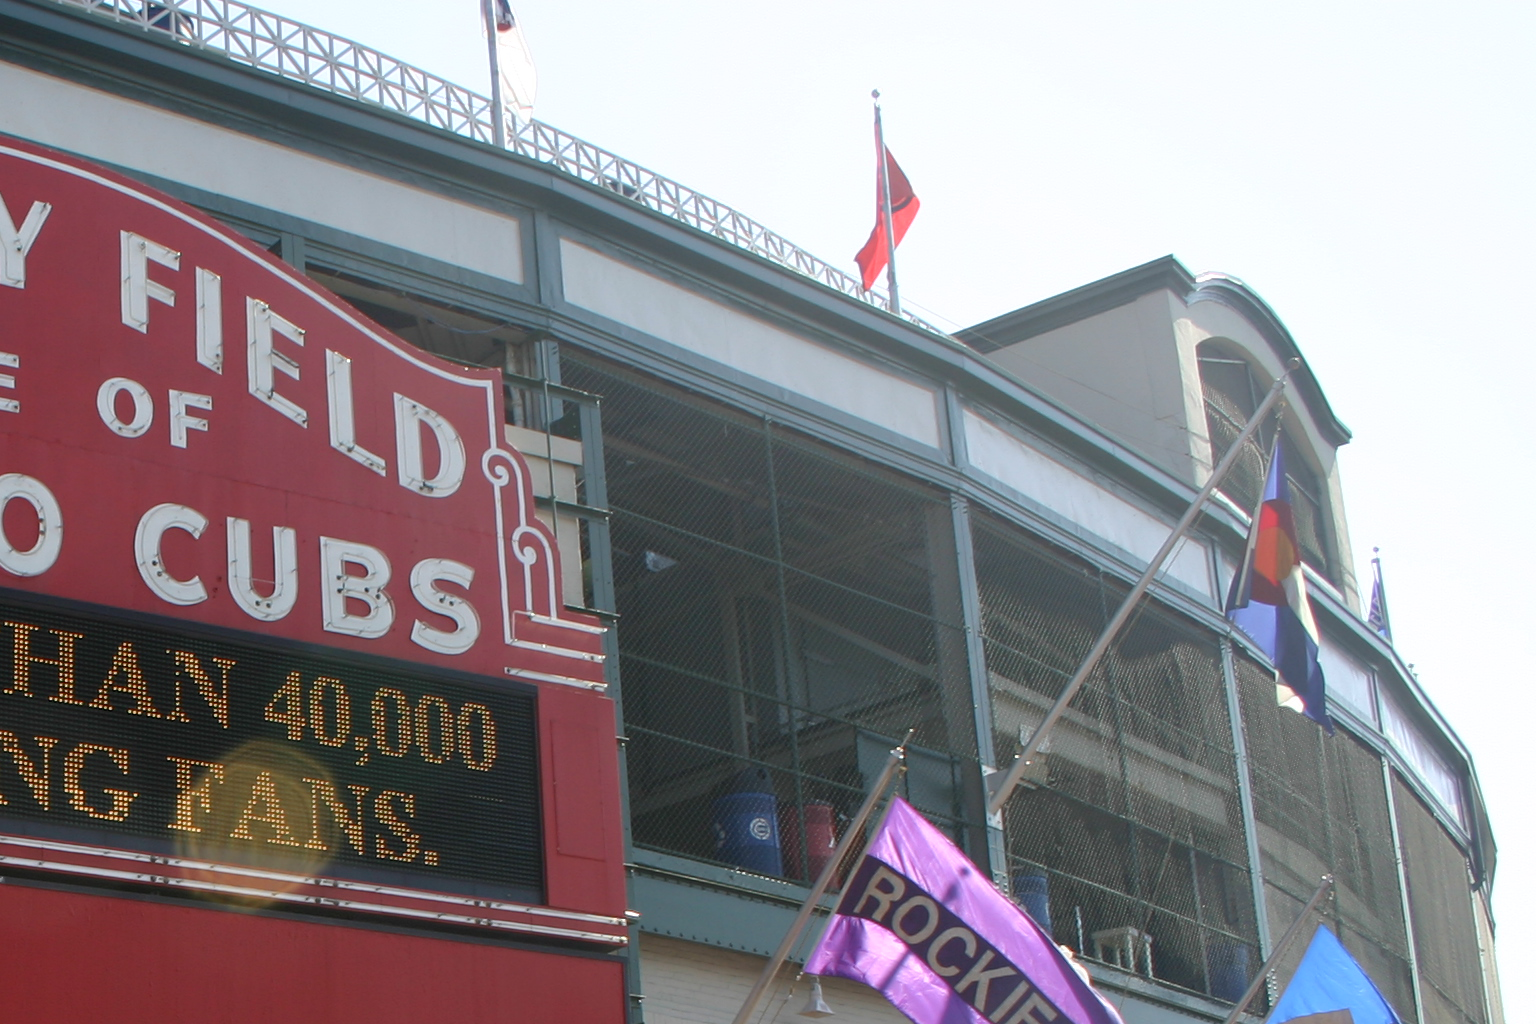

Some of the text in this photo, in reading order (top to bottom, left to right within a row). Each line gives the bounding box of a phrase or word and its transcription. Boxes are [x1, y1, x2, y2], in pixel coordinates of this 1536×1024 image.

[96, 377, 212, 448] OF
[120, 230, 466, 498] FIELD
[134, 503, 480, 654] CUBS
[264, 671, 498, 772] 40,000
[166, 757, 439, 865] FANS.
